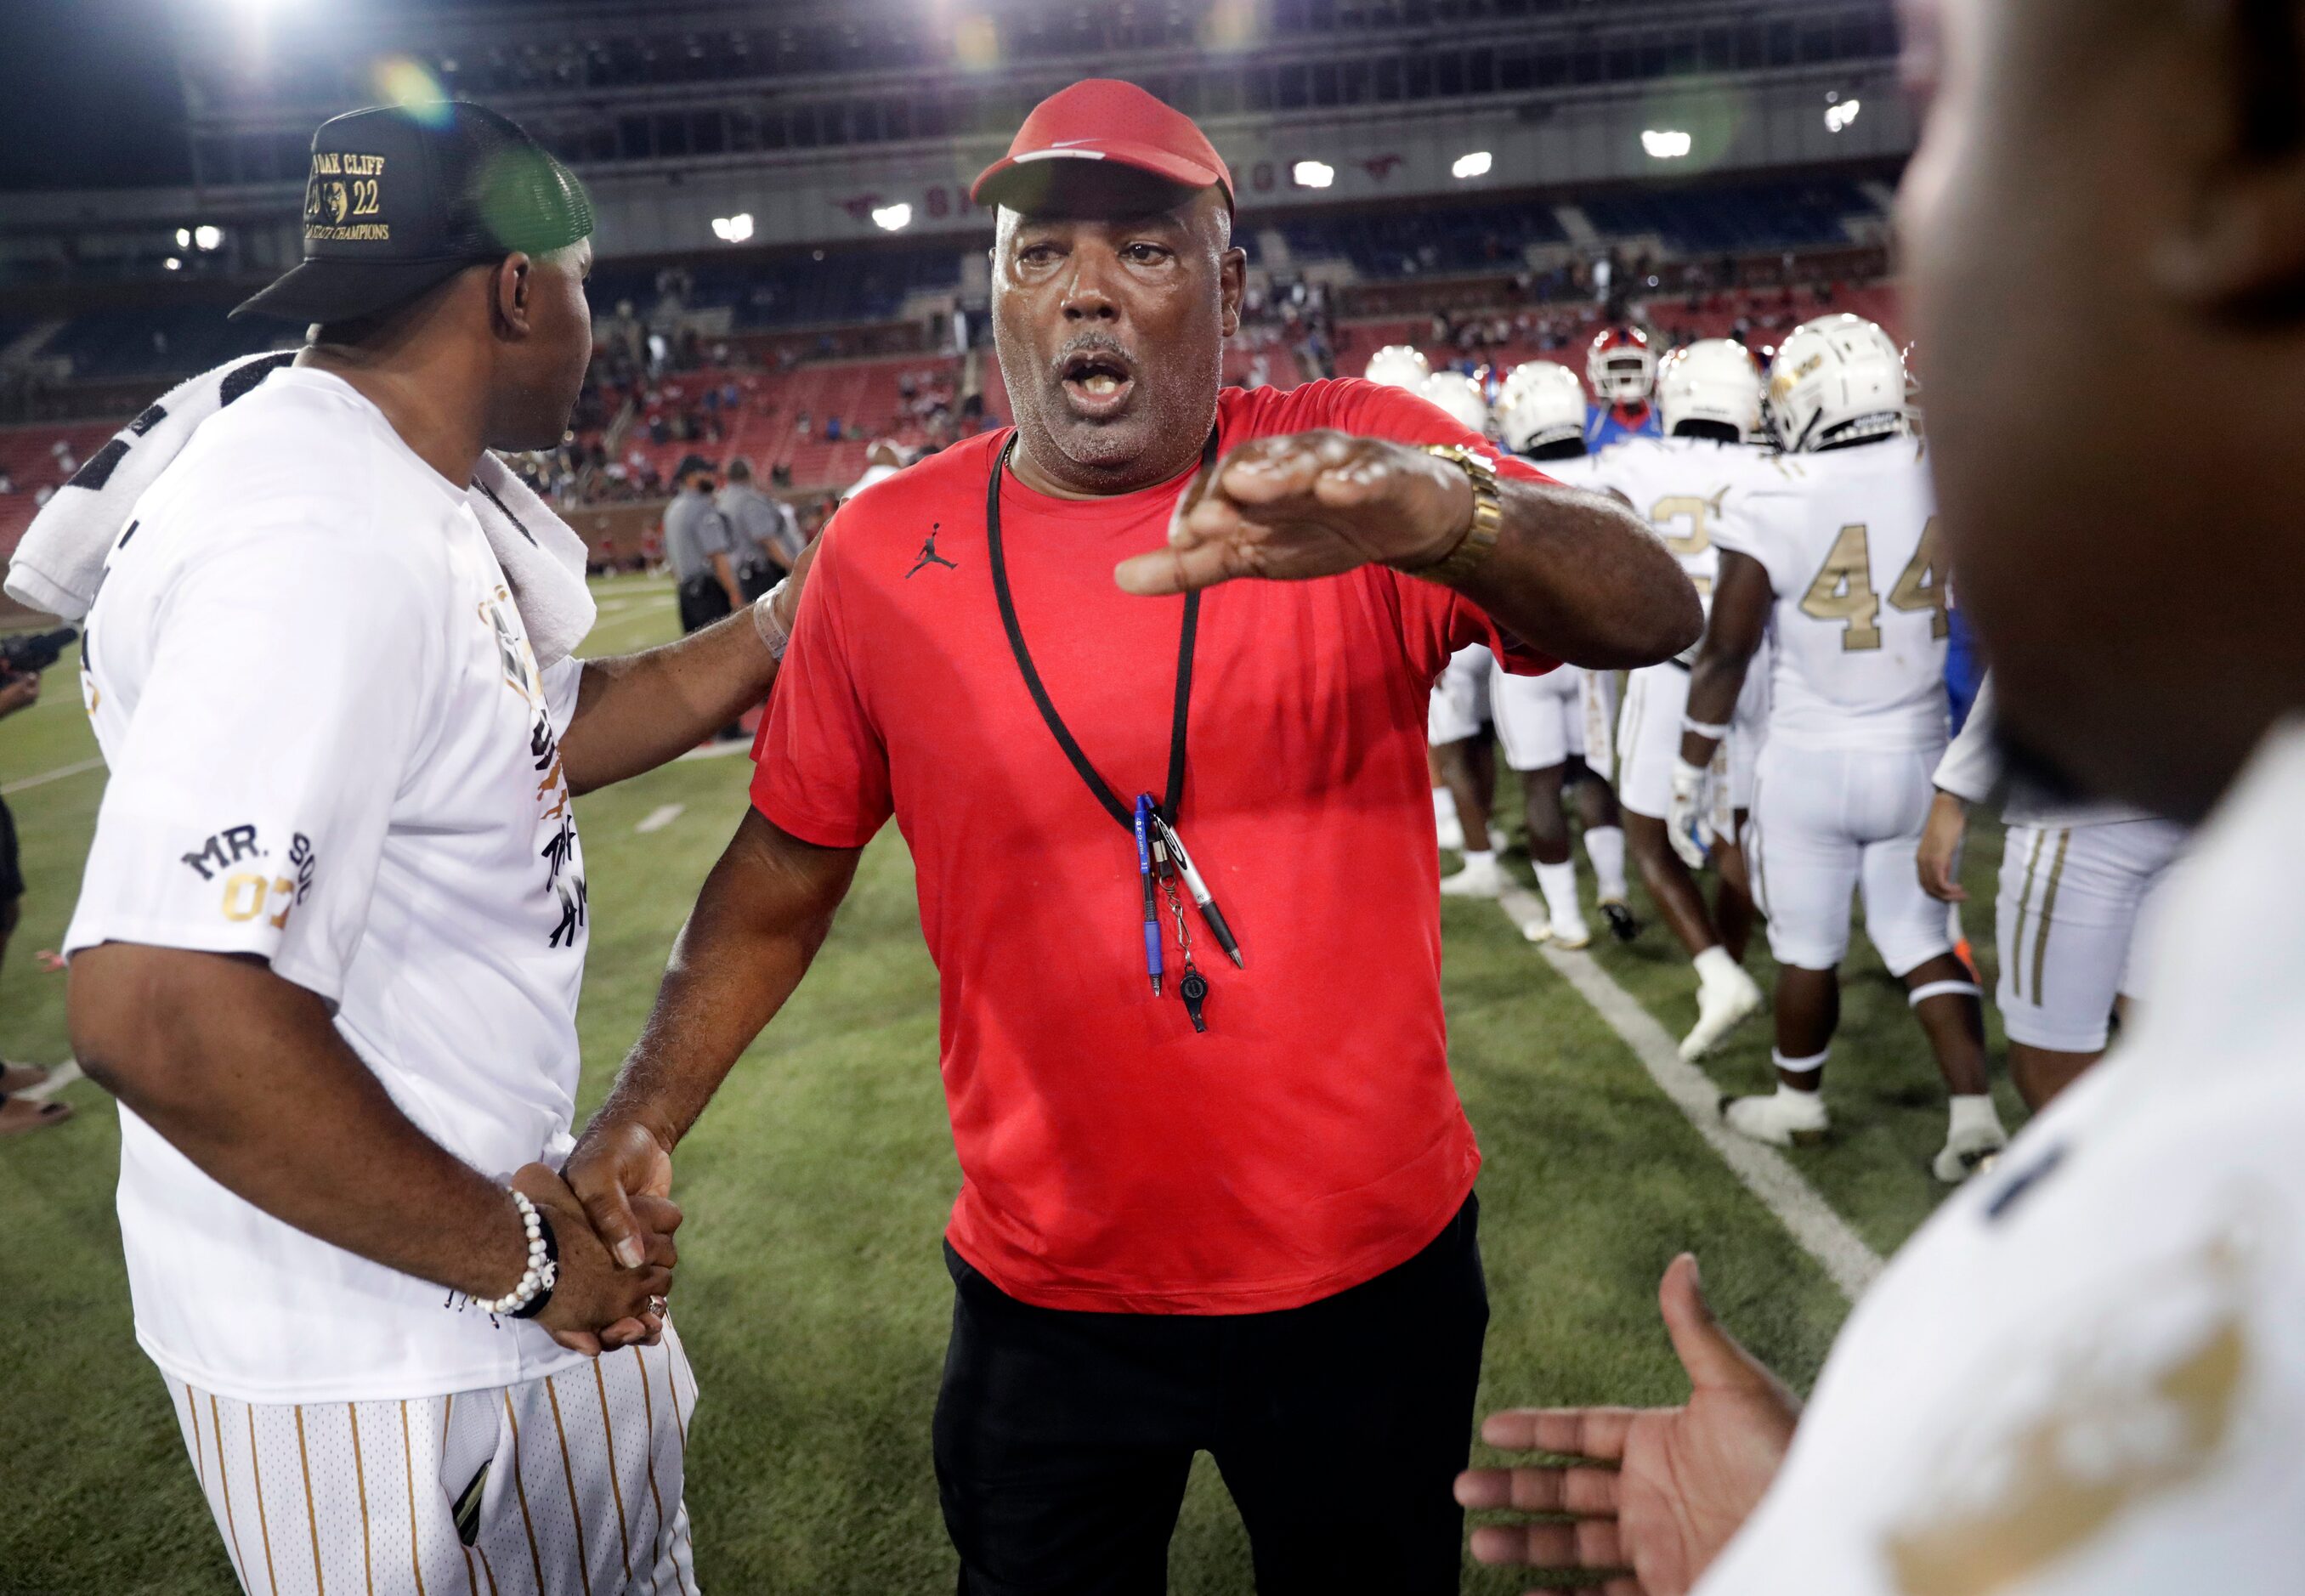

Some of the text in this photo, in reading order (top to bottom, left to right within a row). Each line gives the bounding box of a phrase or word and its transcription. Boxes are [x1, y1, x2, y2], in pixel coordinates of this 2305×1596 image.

[343, 154, 385, 176] CLIFF
[353, 178, 379, 215] 22
[332, 224, 389, 240] CHAMPIONS
[1798, 515, 1950, 653] 44
[181, 823, 269, 881] MR.
